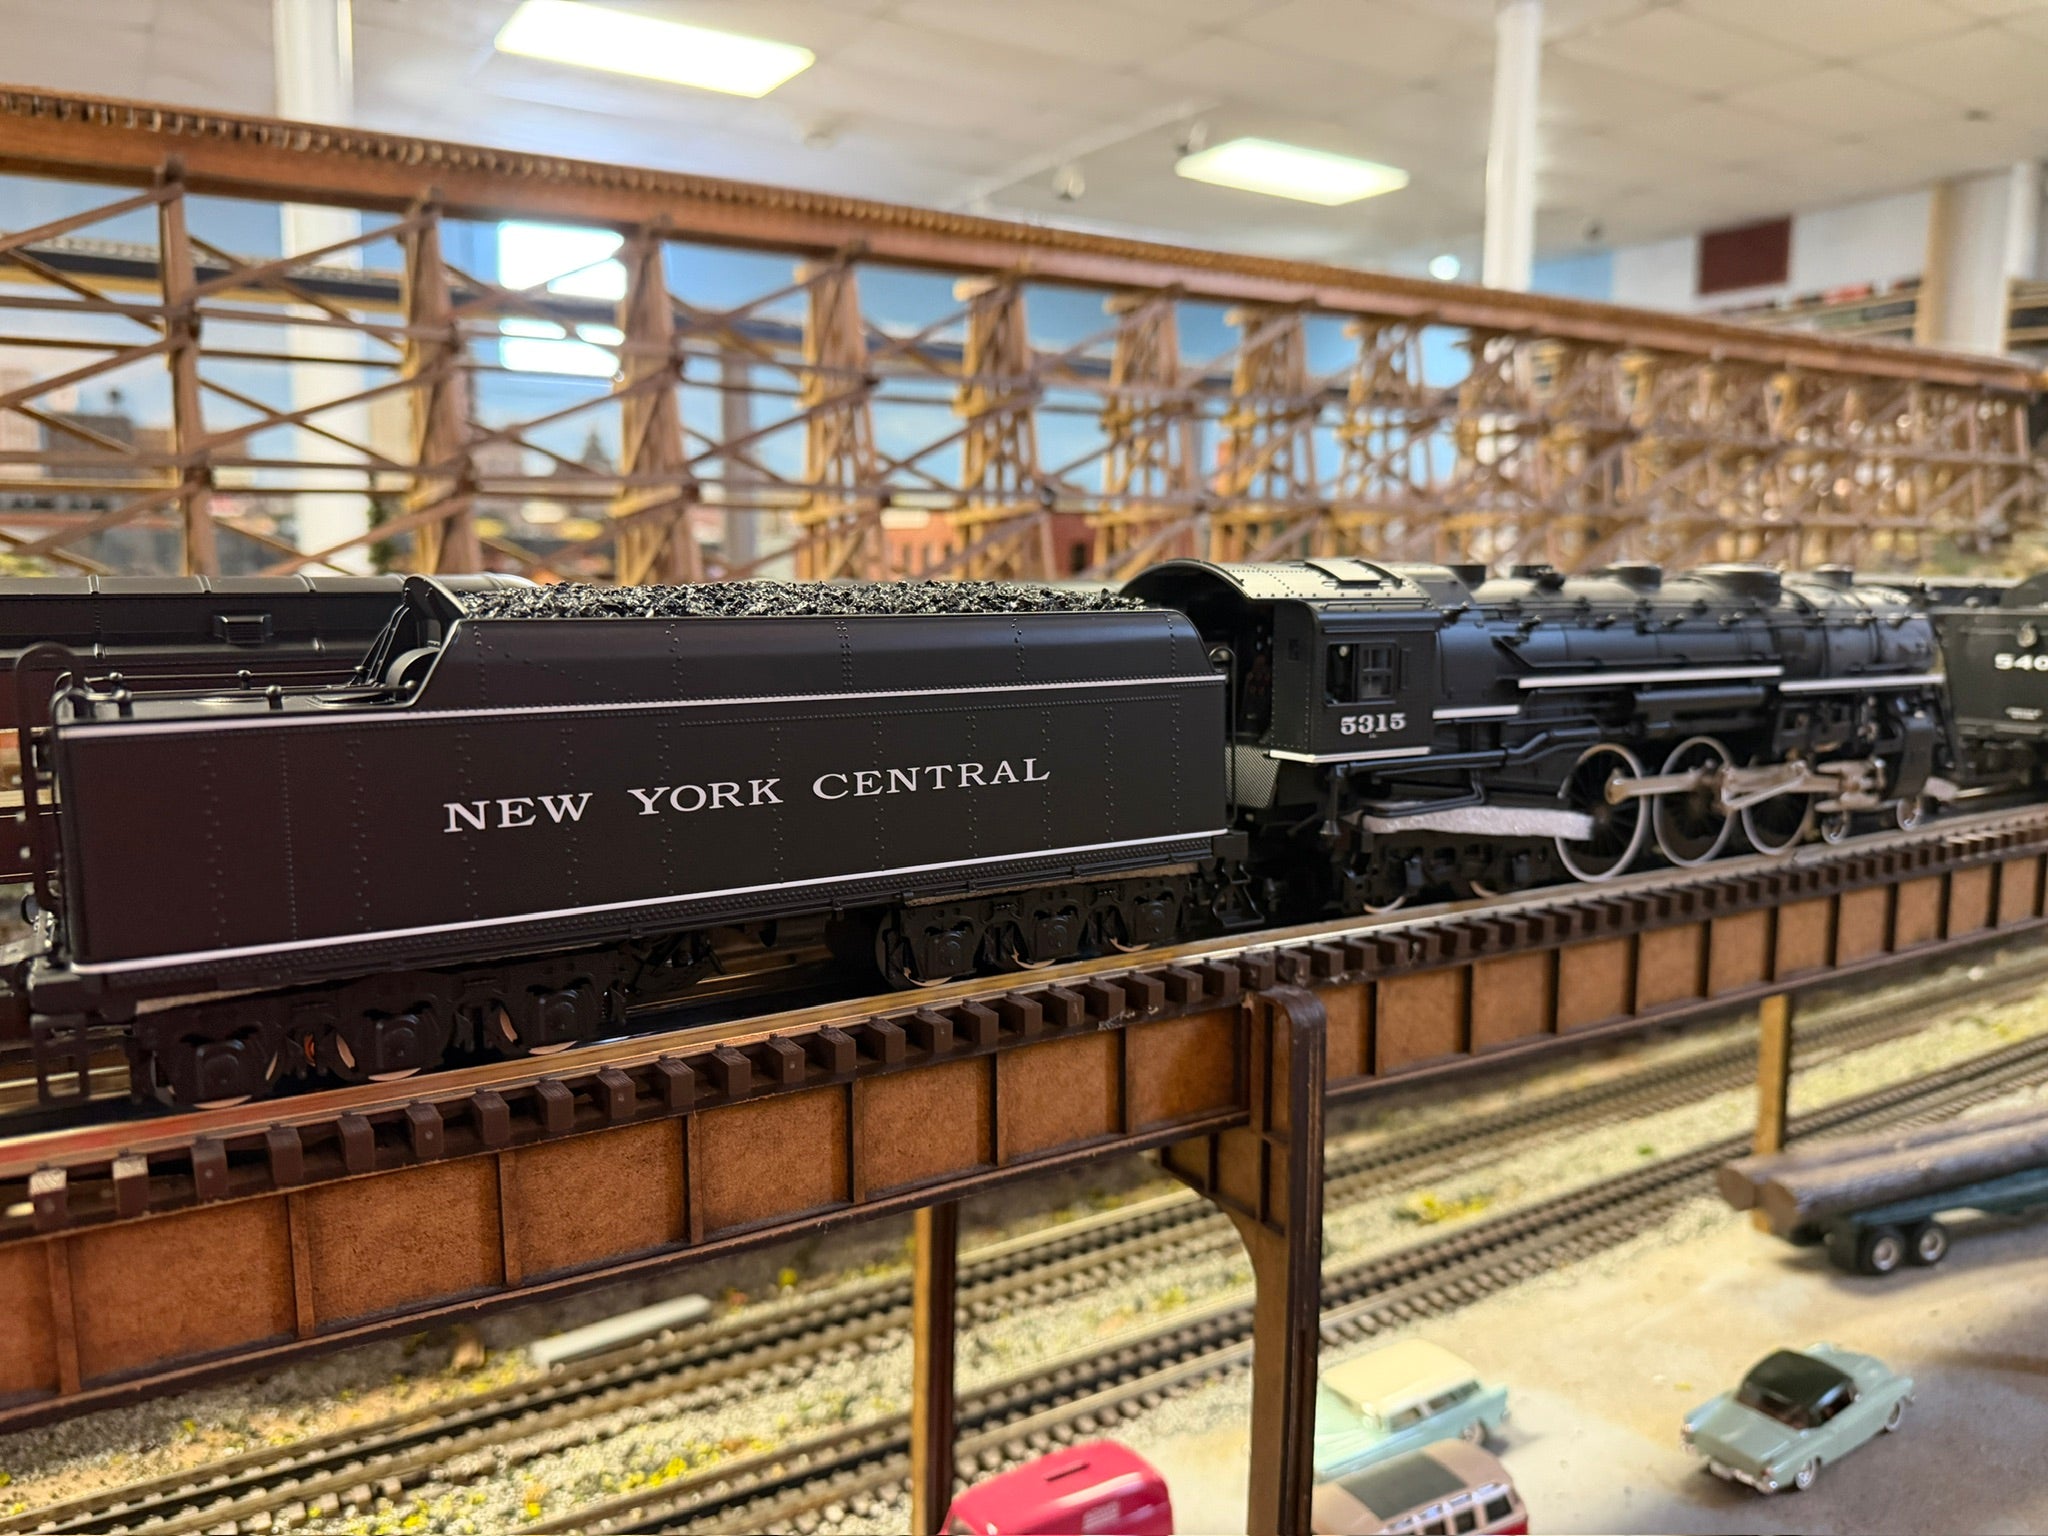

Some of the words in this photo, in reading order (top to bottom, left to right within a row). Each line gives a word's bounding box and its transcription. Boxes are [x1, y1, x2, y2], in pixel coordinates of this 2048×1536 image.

[1340, 712, 1406, 735] 5315
[443, 792, 593, 833] NEW
[626, 778, 784, 816] YORK
[811, 758, 1051, 800] CENTRAL
